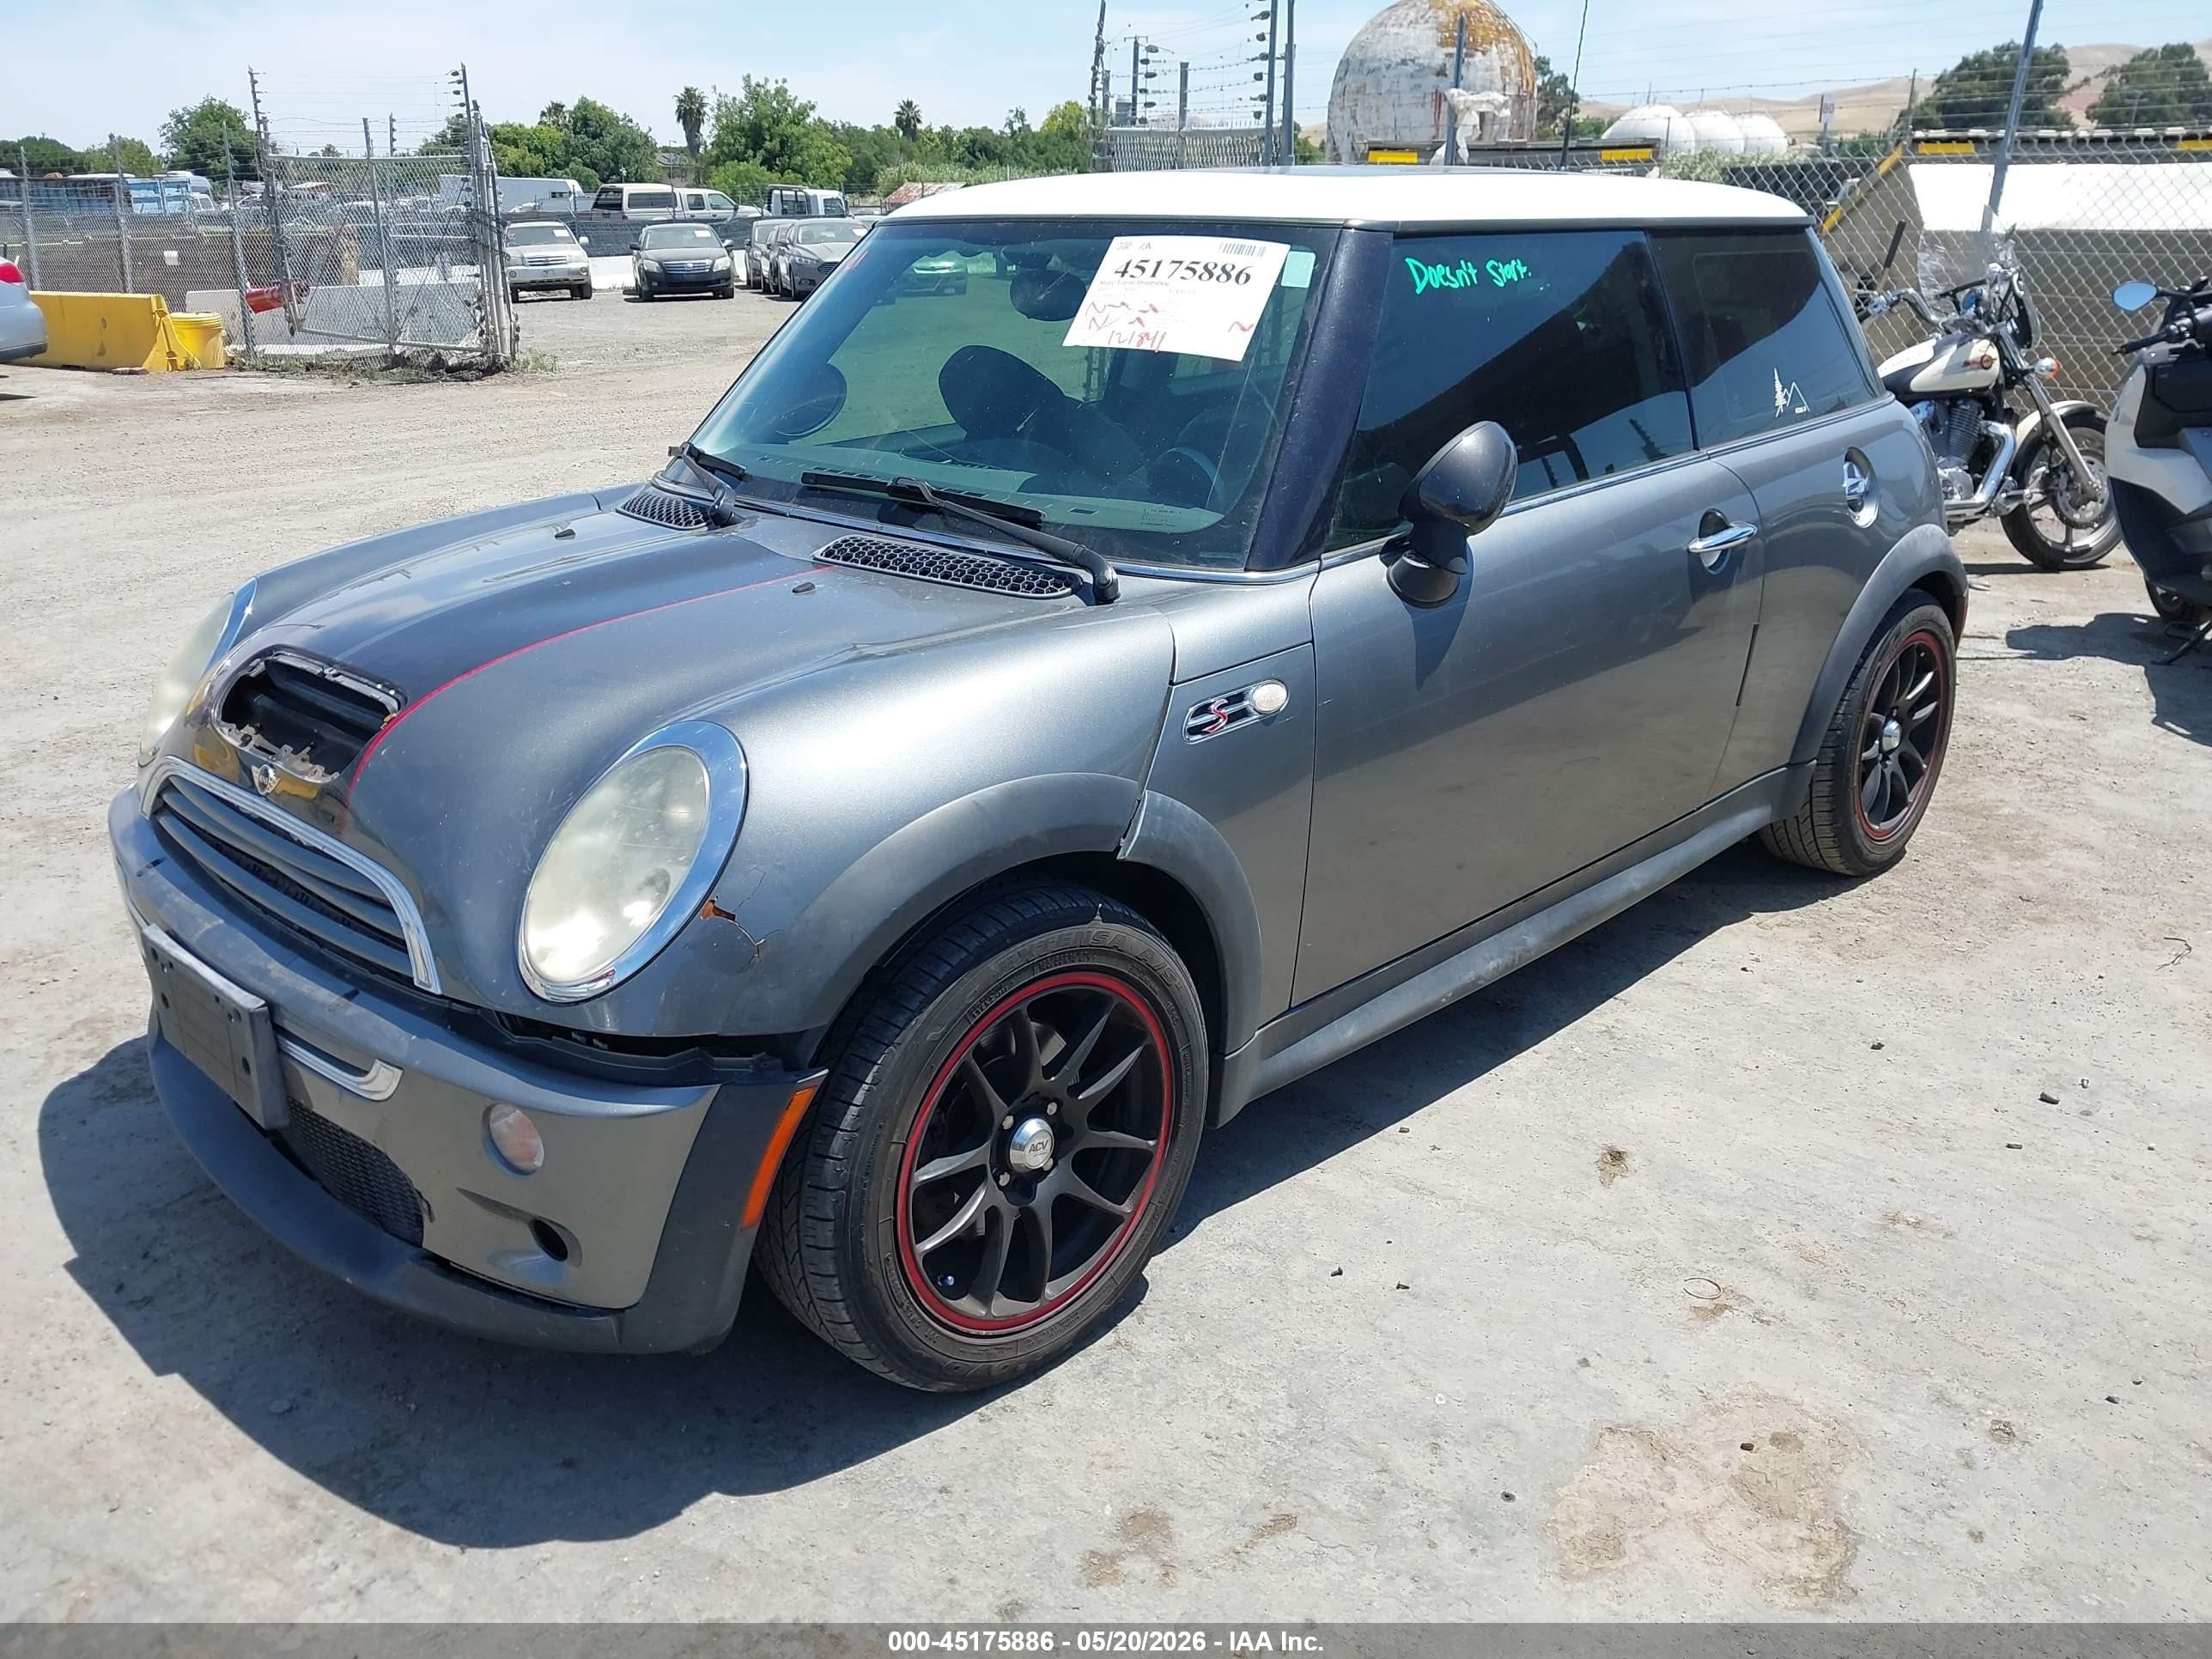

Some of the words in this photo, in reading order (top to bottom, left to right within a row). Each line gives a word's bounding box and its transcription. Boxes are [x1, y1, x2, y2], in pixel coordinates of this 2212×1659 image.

[1114, 259, 1257, 286] 45175886
[1405, 257, 1478, 295] Doesn't
[1202, 698, 1229, 733] S
[1028, 1139, 1048, 1154] ACV
